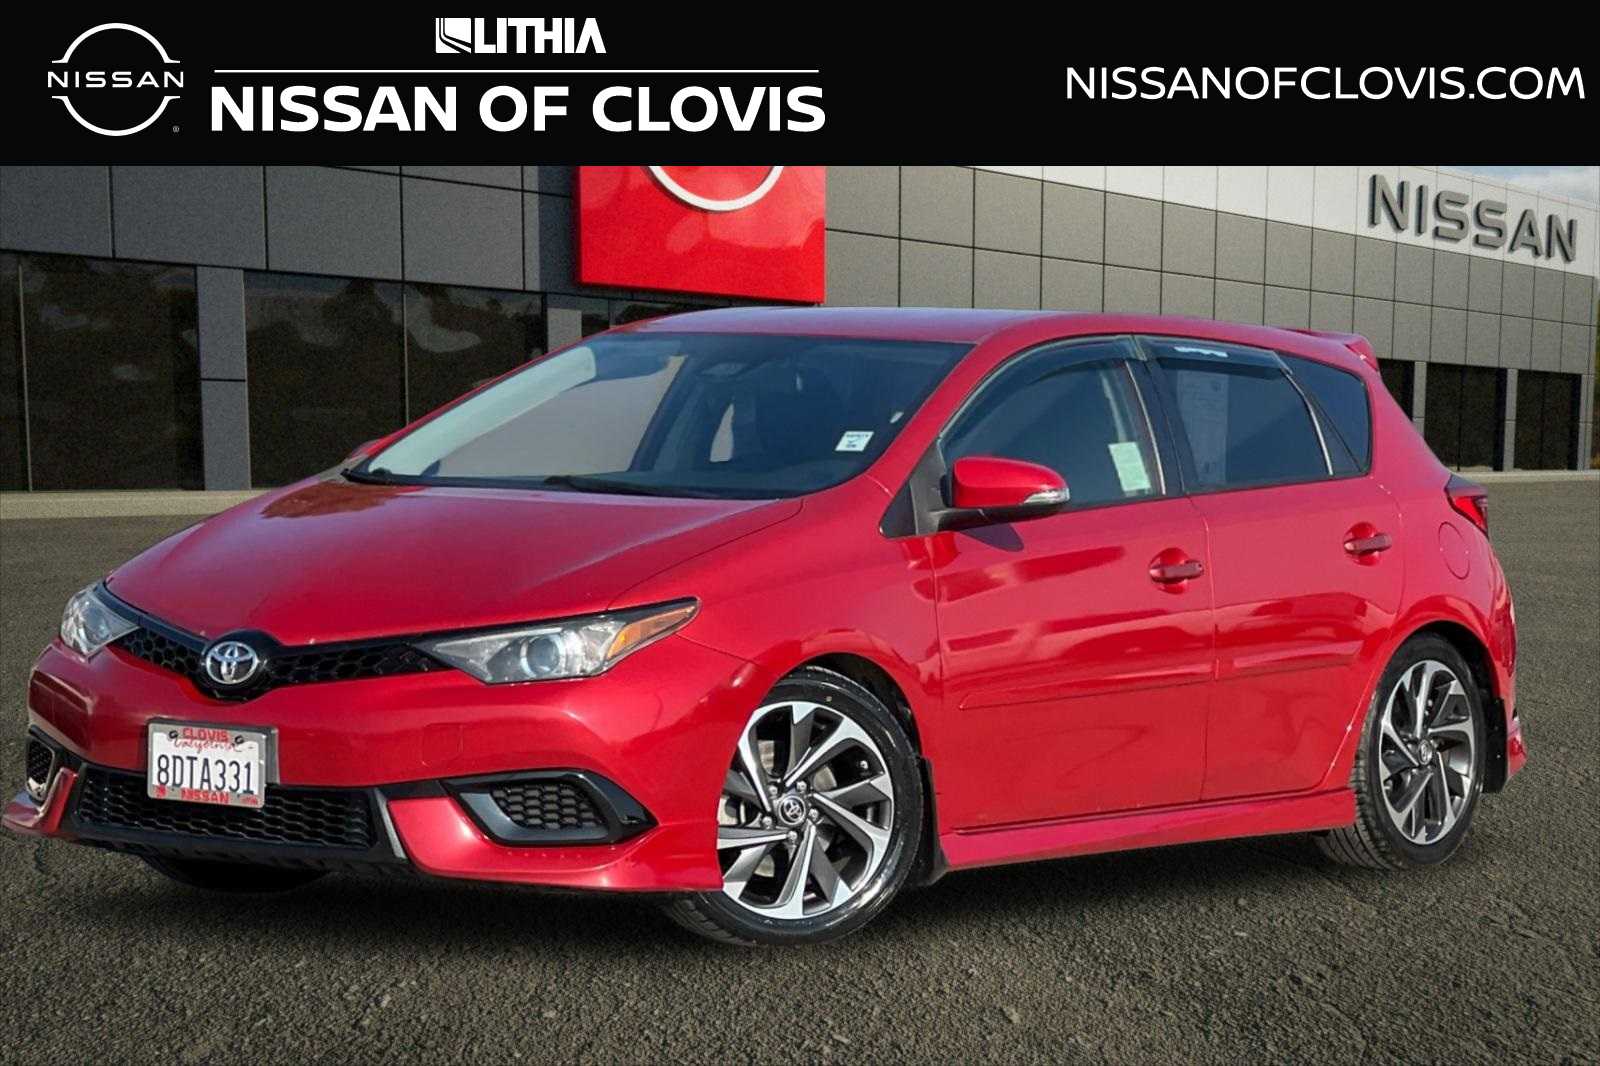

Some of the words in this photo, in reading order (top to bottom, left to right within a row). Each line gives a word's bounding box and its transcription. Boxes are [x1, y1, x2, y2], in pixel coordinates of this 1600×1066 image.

[1368, 173, 1578, 263] NISSAN
[182, 727, 230, 743] CLOVIS
[157, 754, 254, 794] 8DTA331
[180, 787, 230, 804] NISSAN
